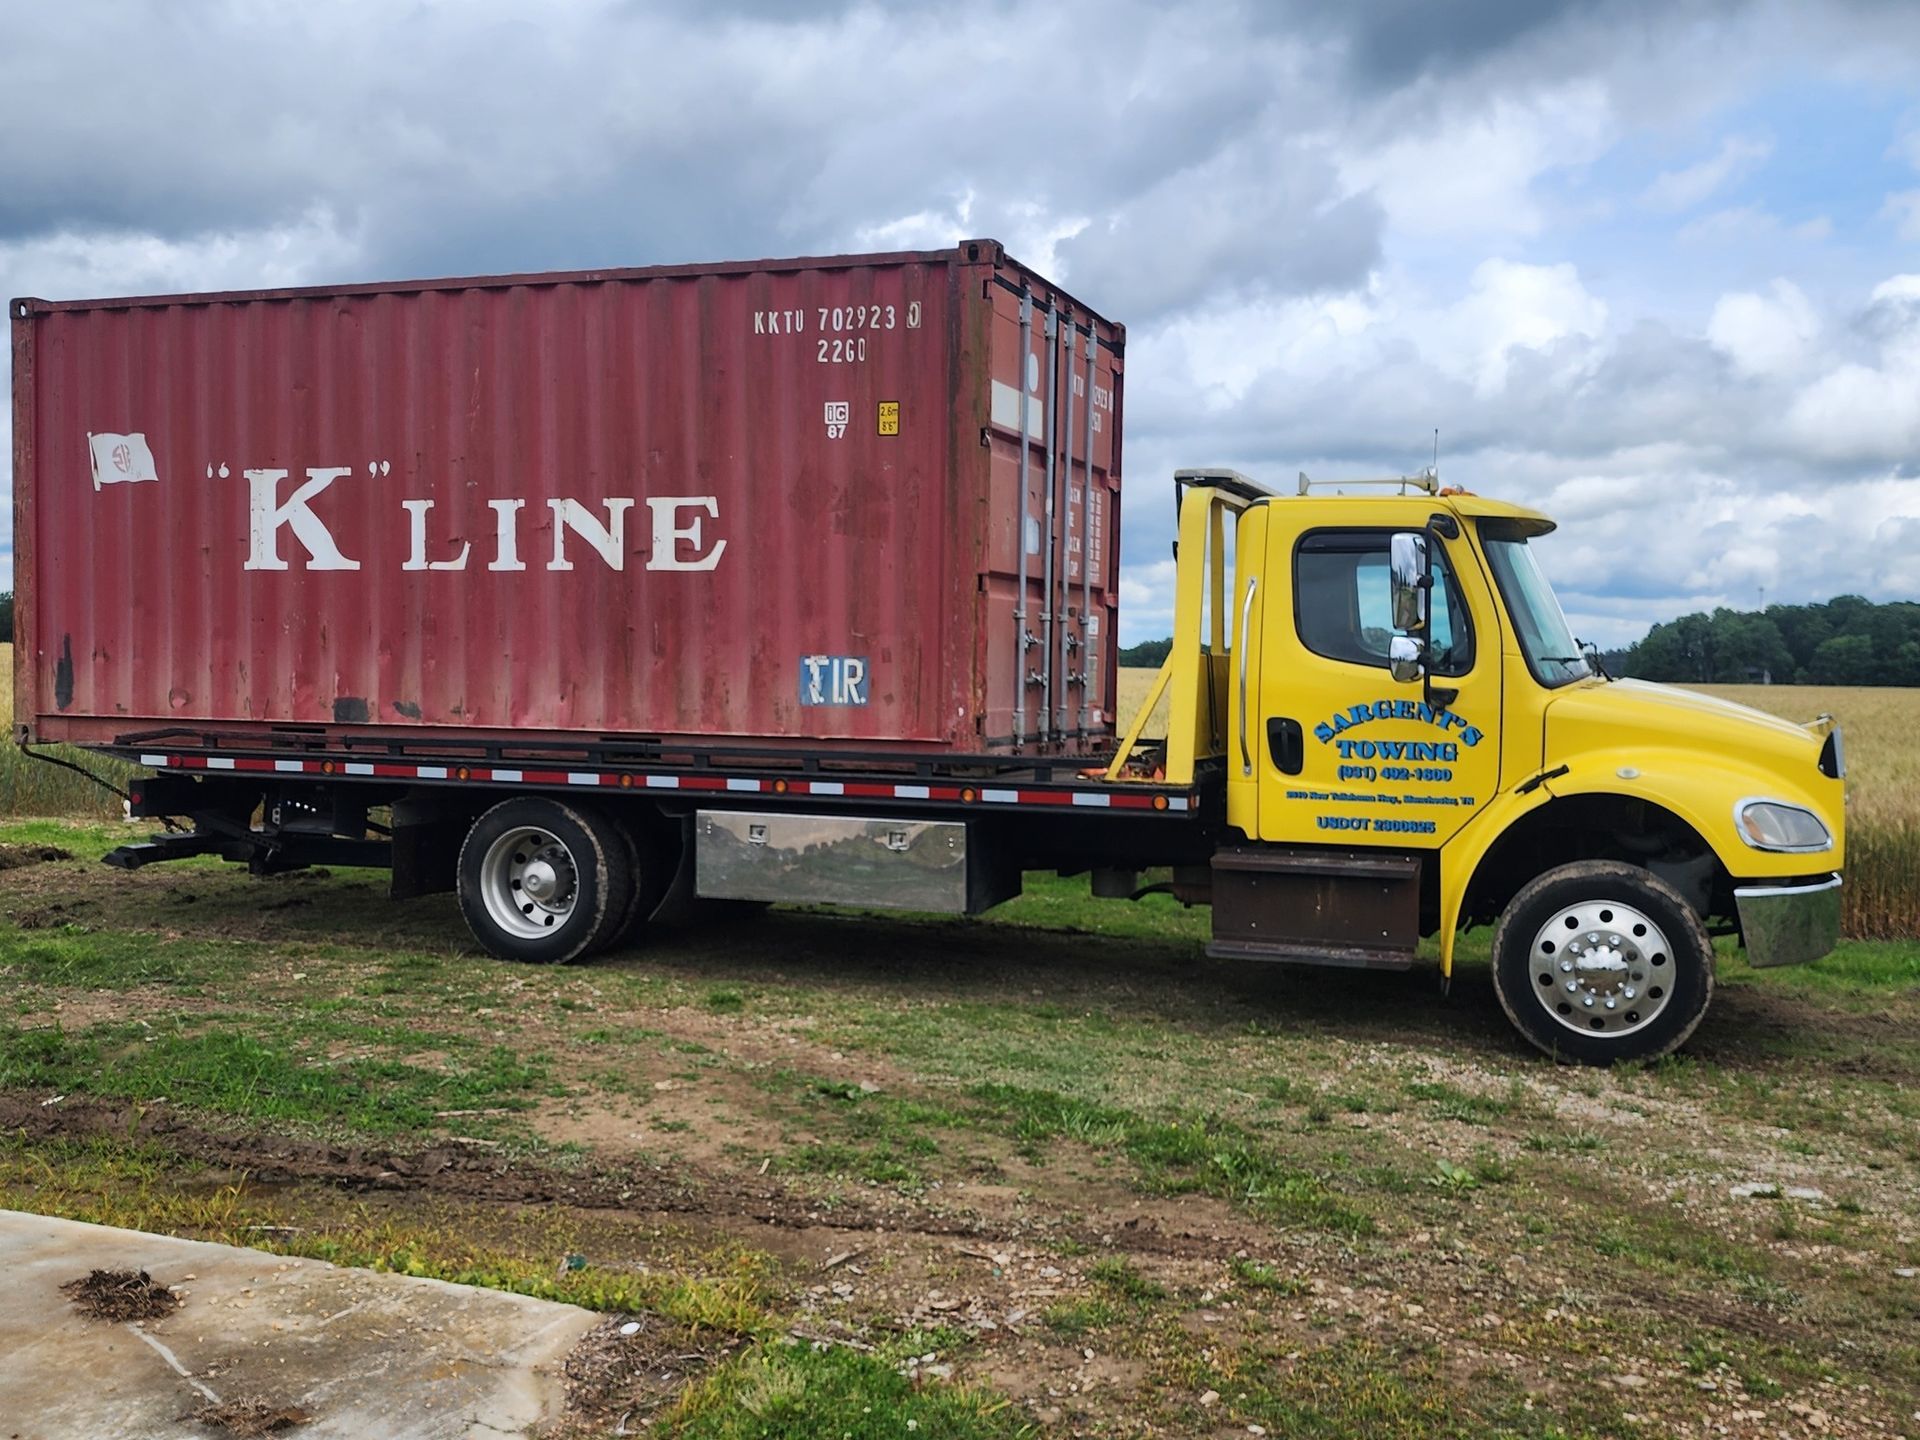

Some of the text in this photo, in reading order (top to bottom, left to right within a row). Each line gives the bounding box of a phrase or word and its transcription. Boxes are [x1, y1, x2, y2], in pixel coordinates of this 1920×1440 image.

[754, 309, 804, 334] KKTU
[817, 305, 896, 332] 702923
[827, 424, 847, 439] 87
[400, 496, 727, 572] LINE
[1314, 699, 1484, 747] SARGENT'S
[1336, 740, 1458, 762] TOWING
[1317, 816, 1371, 832] USDOT
